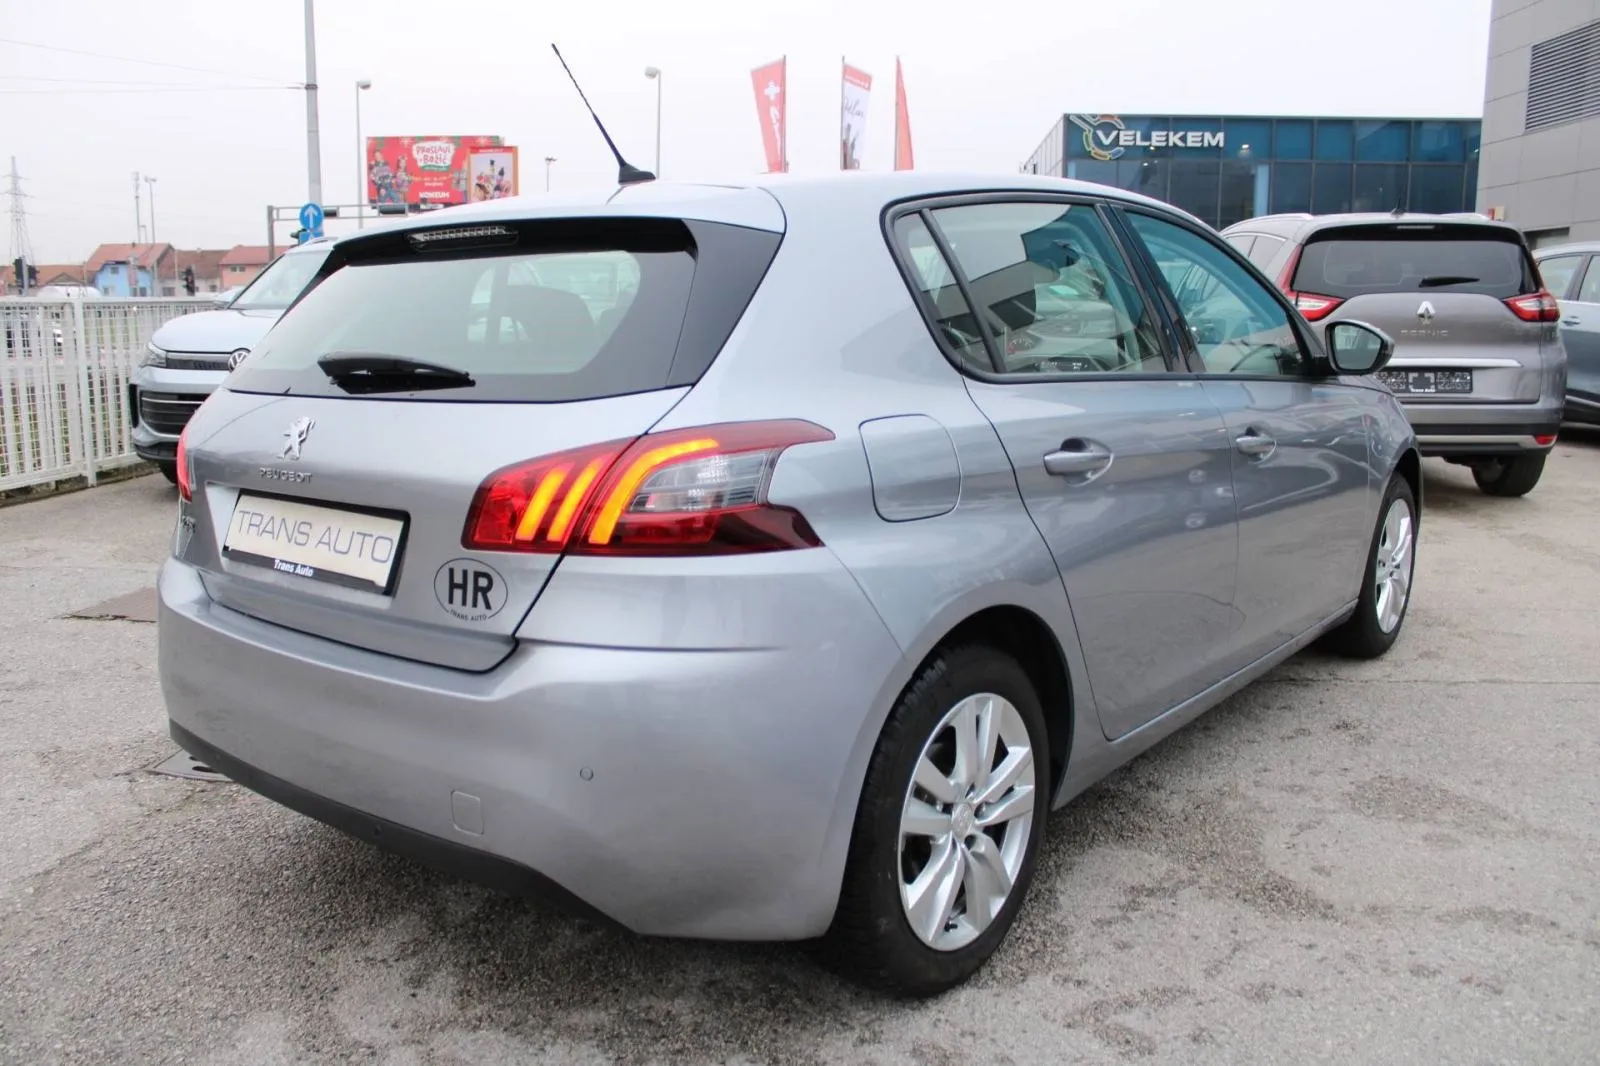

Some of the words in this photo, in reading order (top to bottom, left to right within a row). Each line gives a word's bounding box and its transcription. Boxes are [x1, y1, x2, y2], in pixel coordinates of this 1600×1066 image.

[1096, 130, 1225, 147] VELEKEM
[259, 467, 312, 484] PEUGEOT
[238, 509, 313, 547] TRANS
[315, 526, 393, 564] AUTO
[274, 559, 295, 573] Trans
[294, 564, 314, 577] Auto
[448, 567, 494, 611] HR
